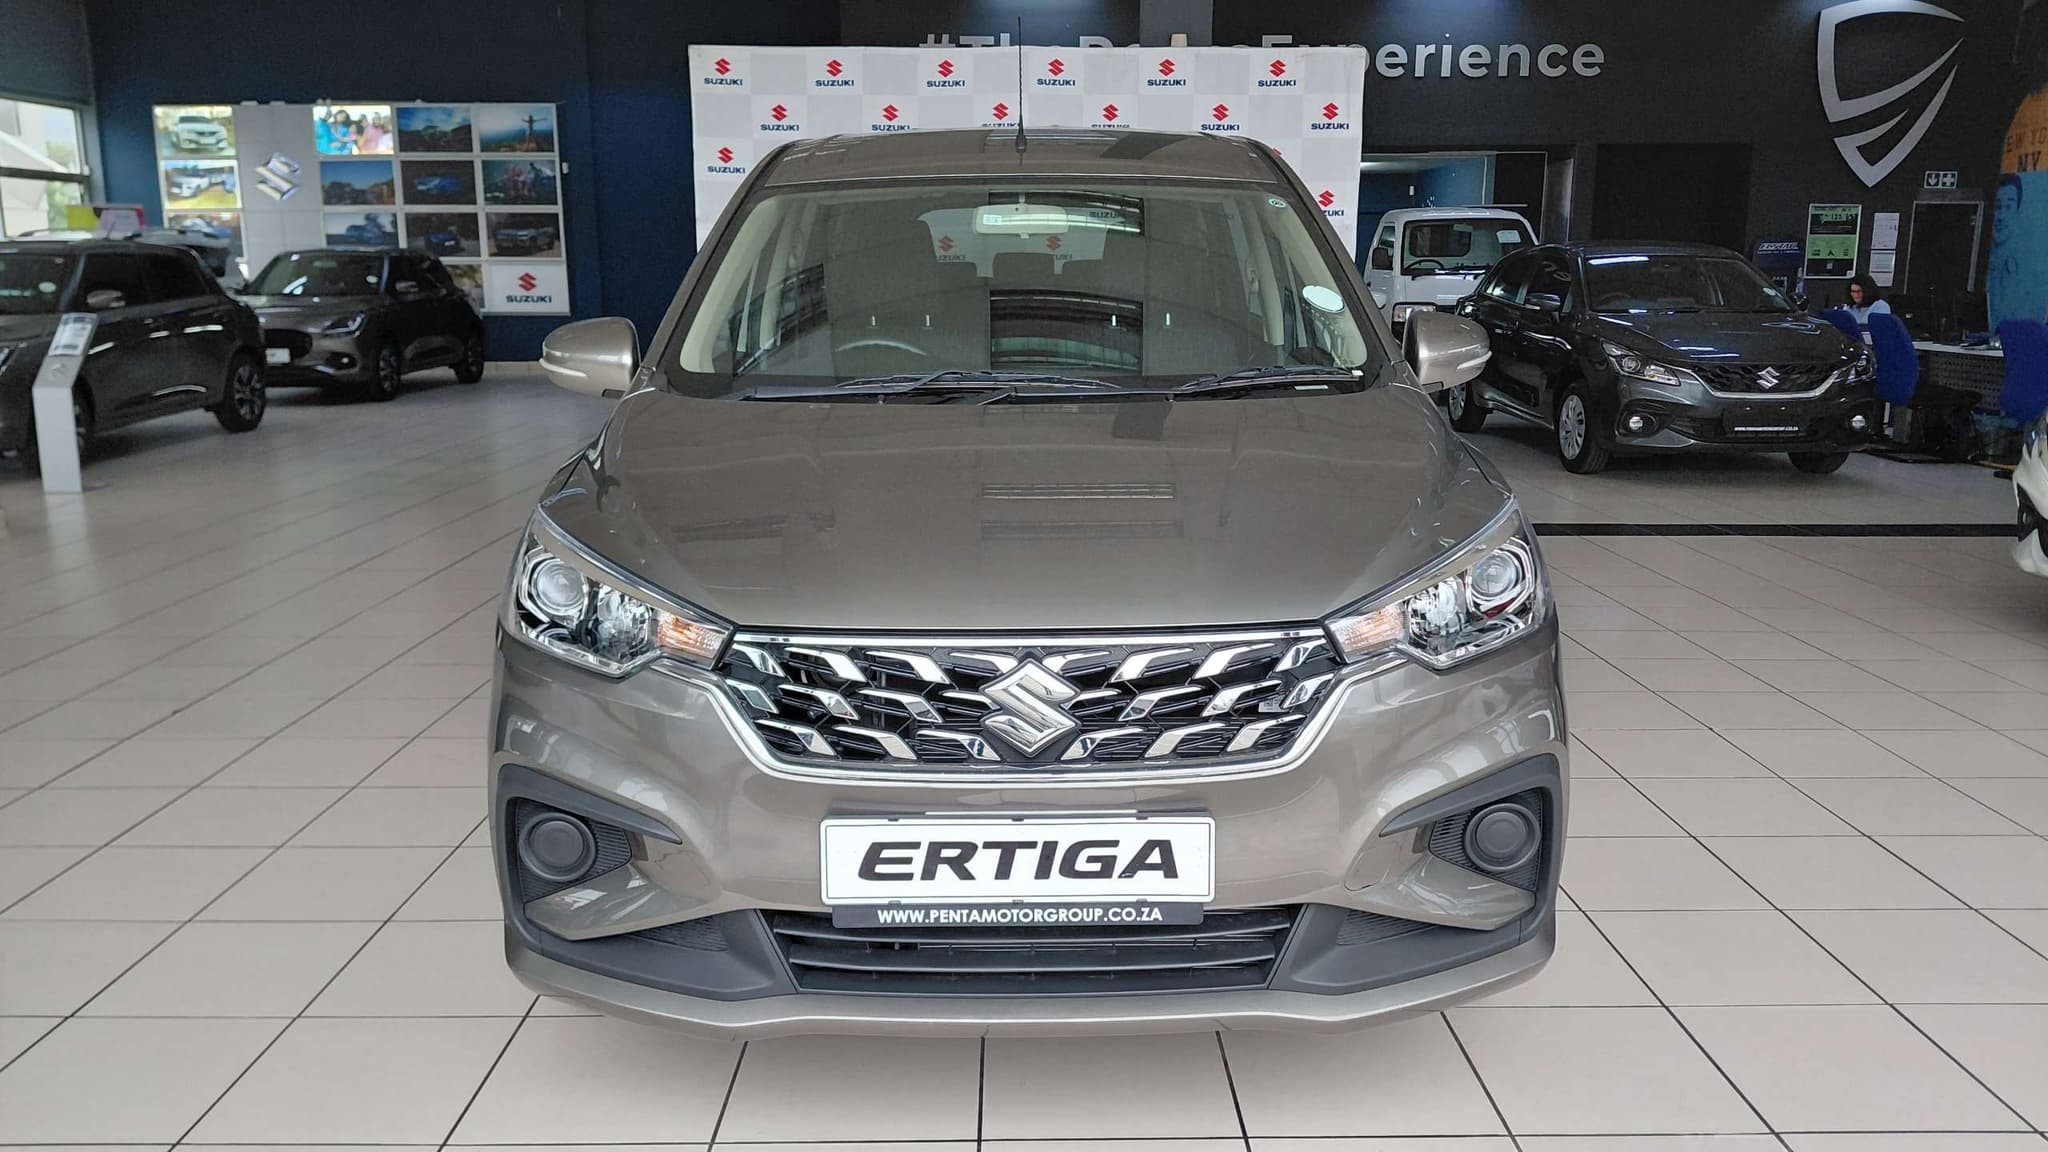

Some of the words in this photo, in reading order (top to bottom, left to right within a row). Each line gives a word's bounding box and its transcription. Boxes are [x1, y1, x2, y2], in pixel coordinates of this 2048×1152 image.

[1262, 34, 1605, 79] erience
[704, 77, 743, 86] SUZUKI
[815, 79, 854, 87] SUZUKI
[926, 79, 965, 88] SUZUKI
[1036, 78, 1076, 87] SUZUKI
[1257, 79, 1297, 87] SUZUKI
[760, 123, 800, 132] SUZUKI
[871, 124, 910, 132] SUZUKI
[1201, 123, 1240, 131] SUZUKI
[1311, 122, 1350, 130] SUZUKI
[2006, 131, 2027, 153] EW
[2031, 126, 2048, 146] YO
[707, 165, 746, 174] SUZUKI
[1323, 209, 1345, 217] ZUKI
[506, 295, 552, 303] SUZUKI
[857, 839, 1179, 882] ERTIGA
[877, 907, 1163, 924] WWW.PENTAMOTORGROUP.CO.ZA
